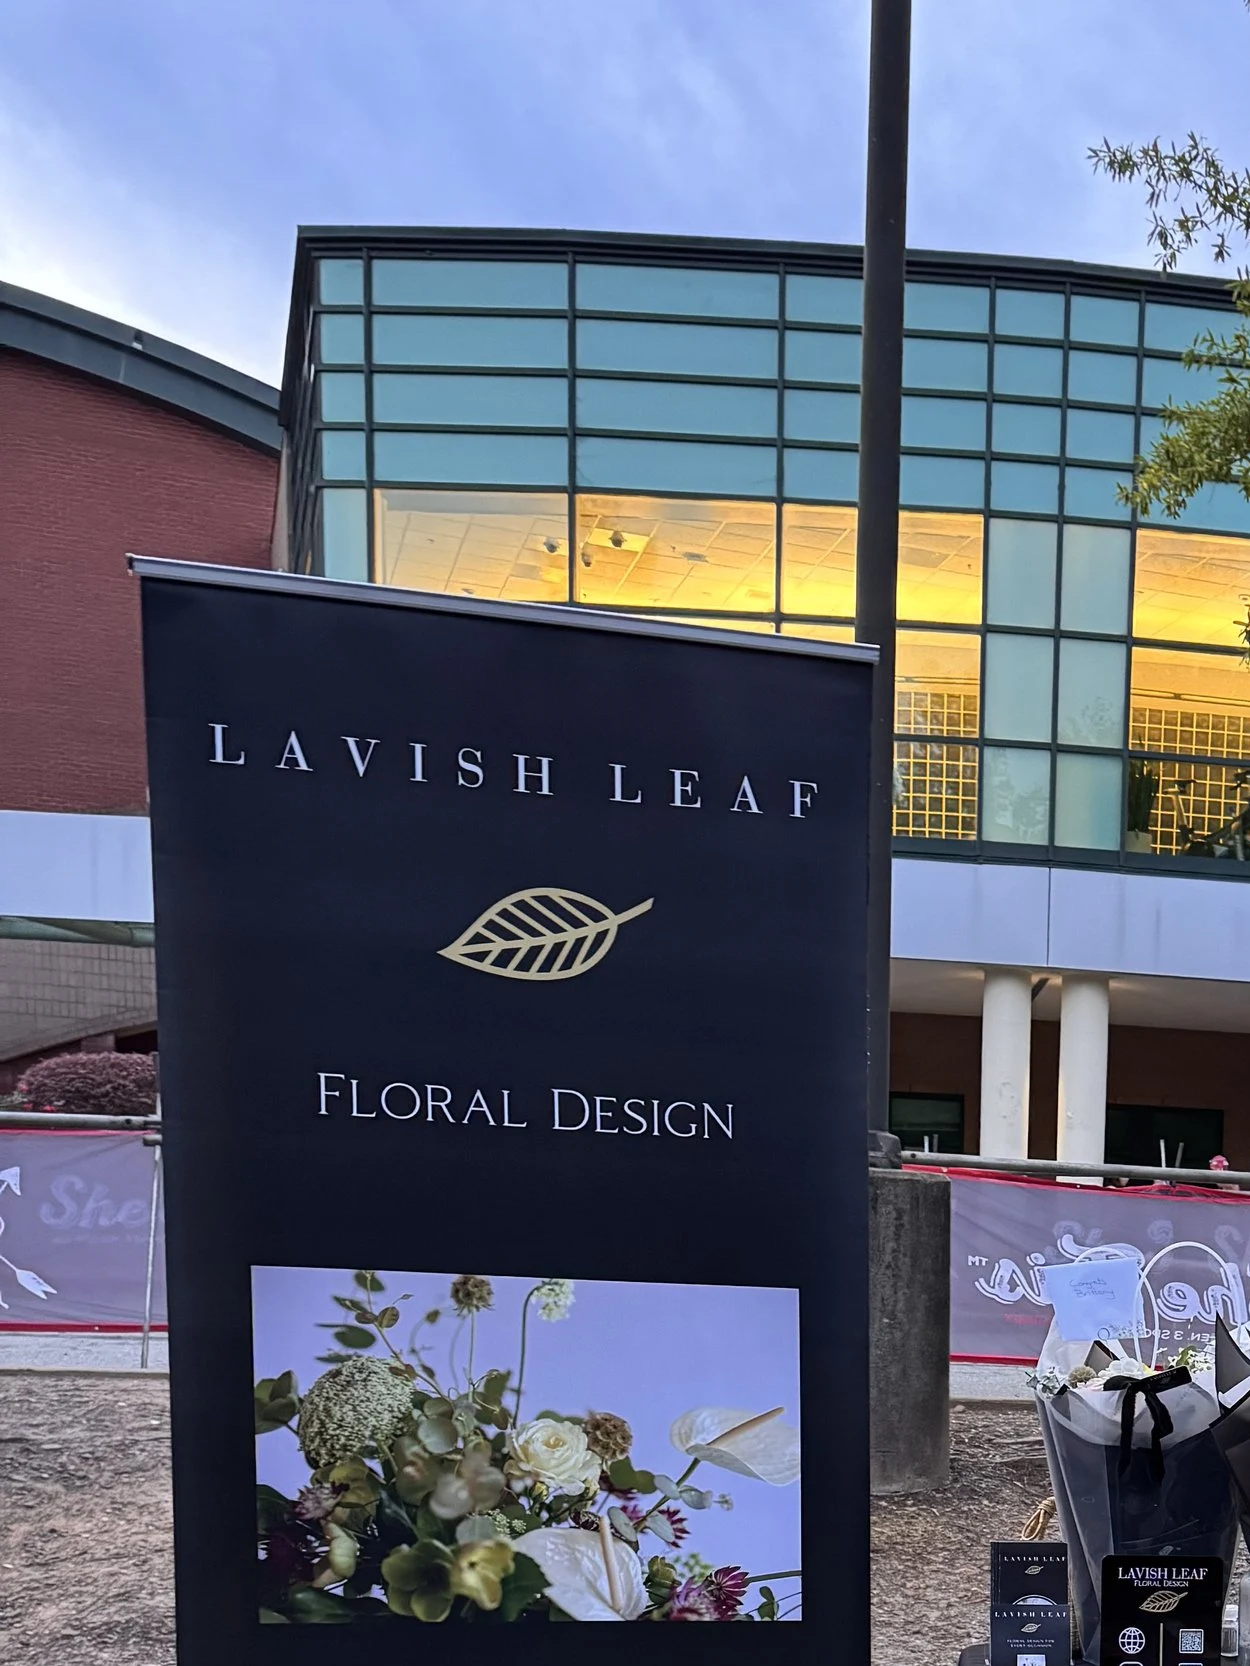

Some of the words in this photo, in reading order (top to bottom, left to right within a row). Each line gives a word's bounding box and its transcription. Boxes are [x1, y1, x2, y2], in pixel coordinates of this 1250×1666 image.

[210, 724, 552, 795] LAVISH
[611, 764, 817, 817] LEAF
[319, 1073, 526, 1127] FLORAL
[552, 1089, 732, 1138] DESIGN
[1118, 1568, 1168, 1580] LAVISH
[1172, 1568, 1208, 1580] LEAF
